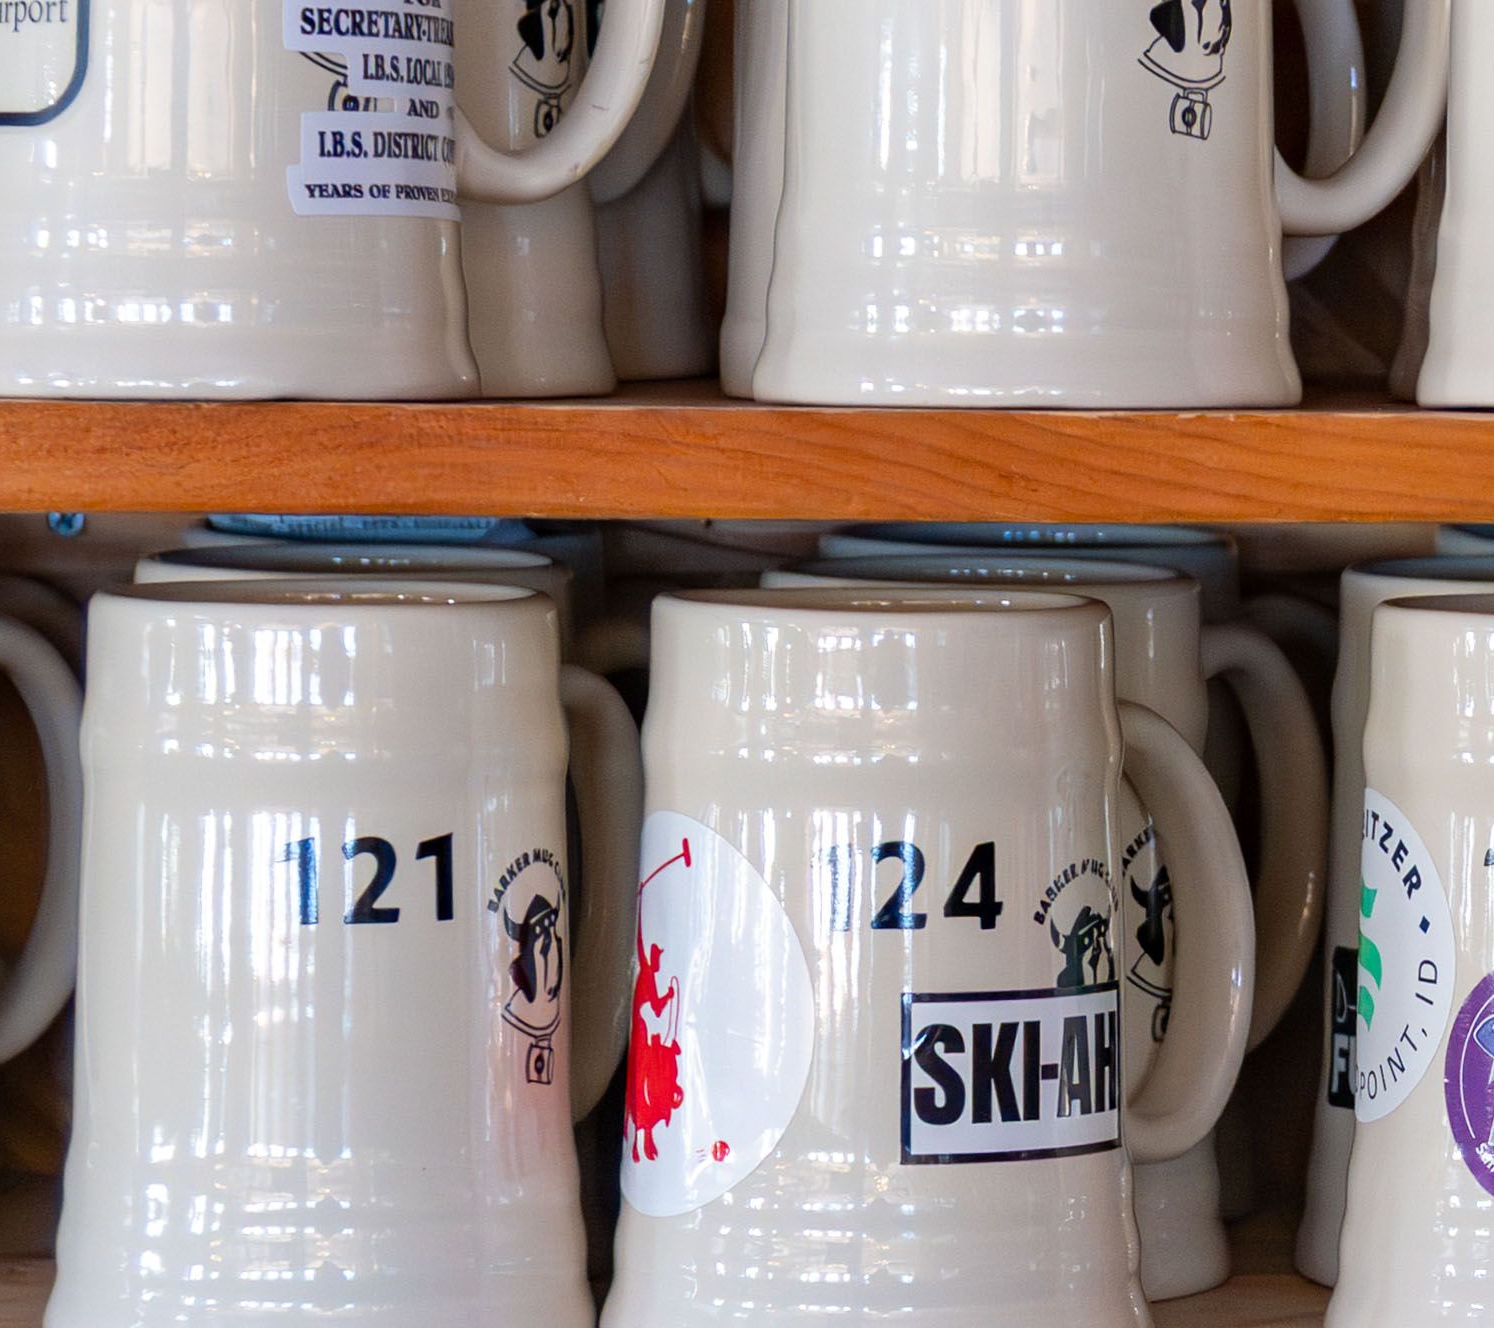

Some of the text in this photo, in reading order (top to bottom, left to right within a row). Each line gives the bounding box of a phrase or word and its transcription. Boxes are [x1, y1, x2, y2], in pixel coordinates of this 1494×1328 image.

[362, 53, 444, 88] I.B.S. LOCAL
[408, 99, 440, 120] AND
[318, 130, 438, 163] I.B.S. DISTRICT
[305, 183, 439, 204] YEARS OF PROVEN
[276, 831, 455, 926] 121
[811, 840, 1004, 931] 124
[1415, 959, 1438, 1007] ID
[913, 1010, 1119, 1127] SKI-AH
